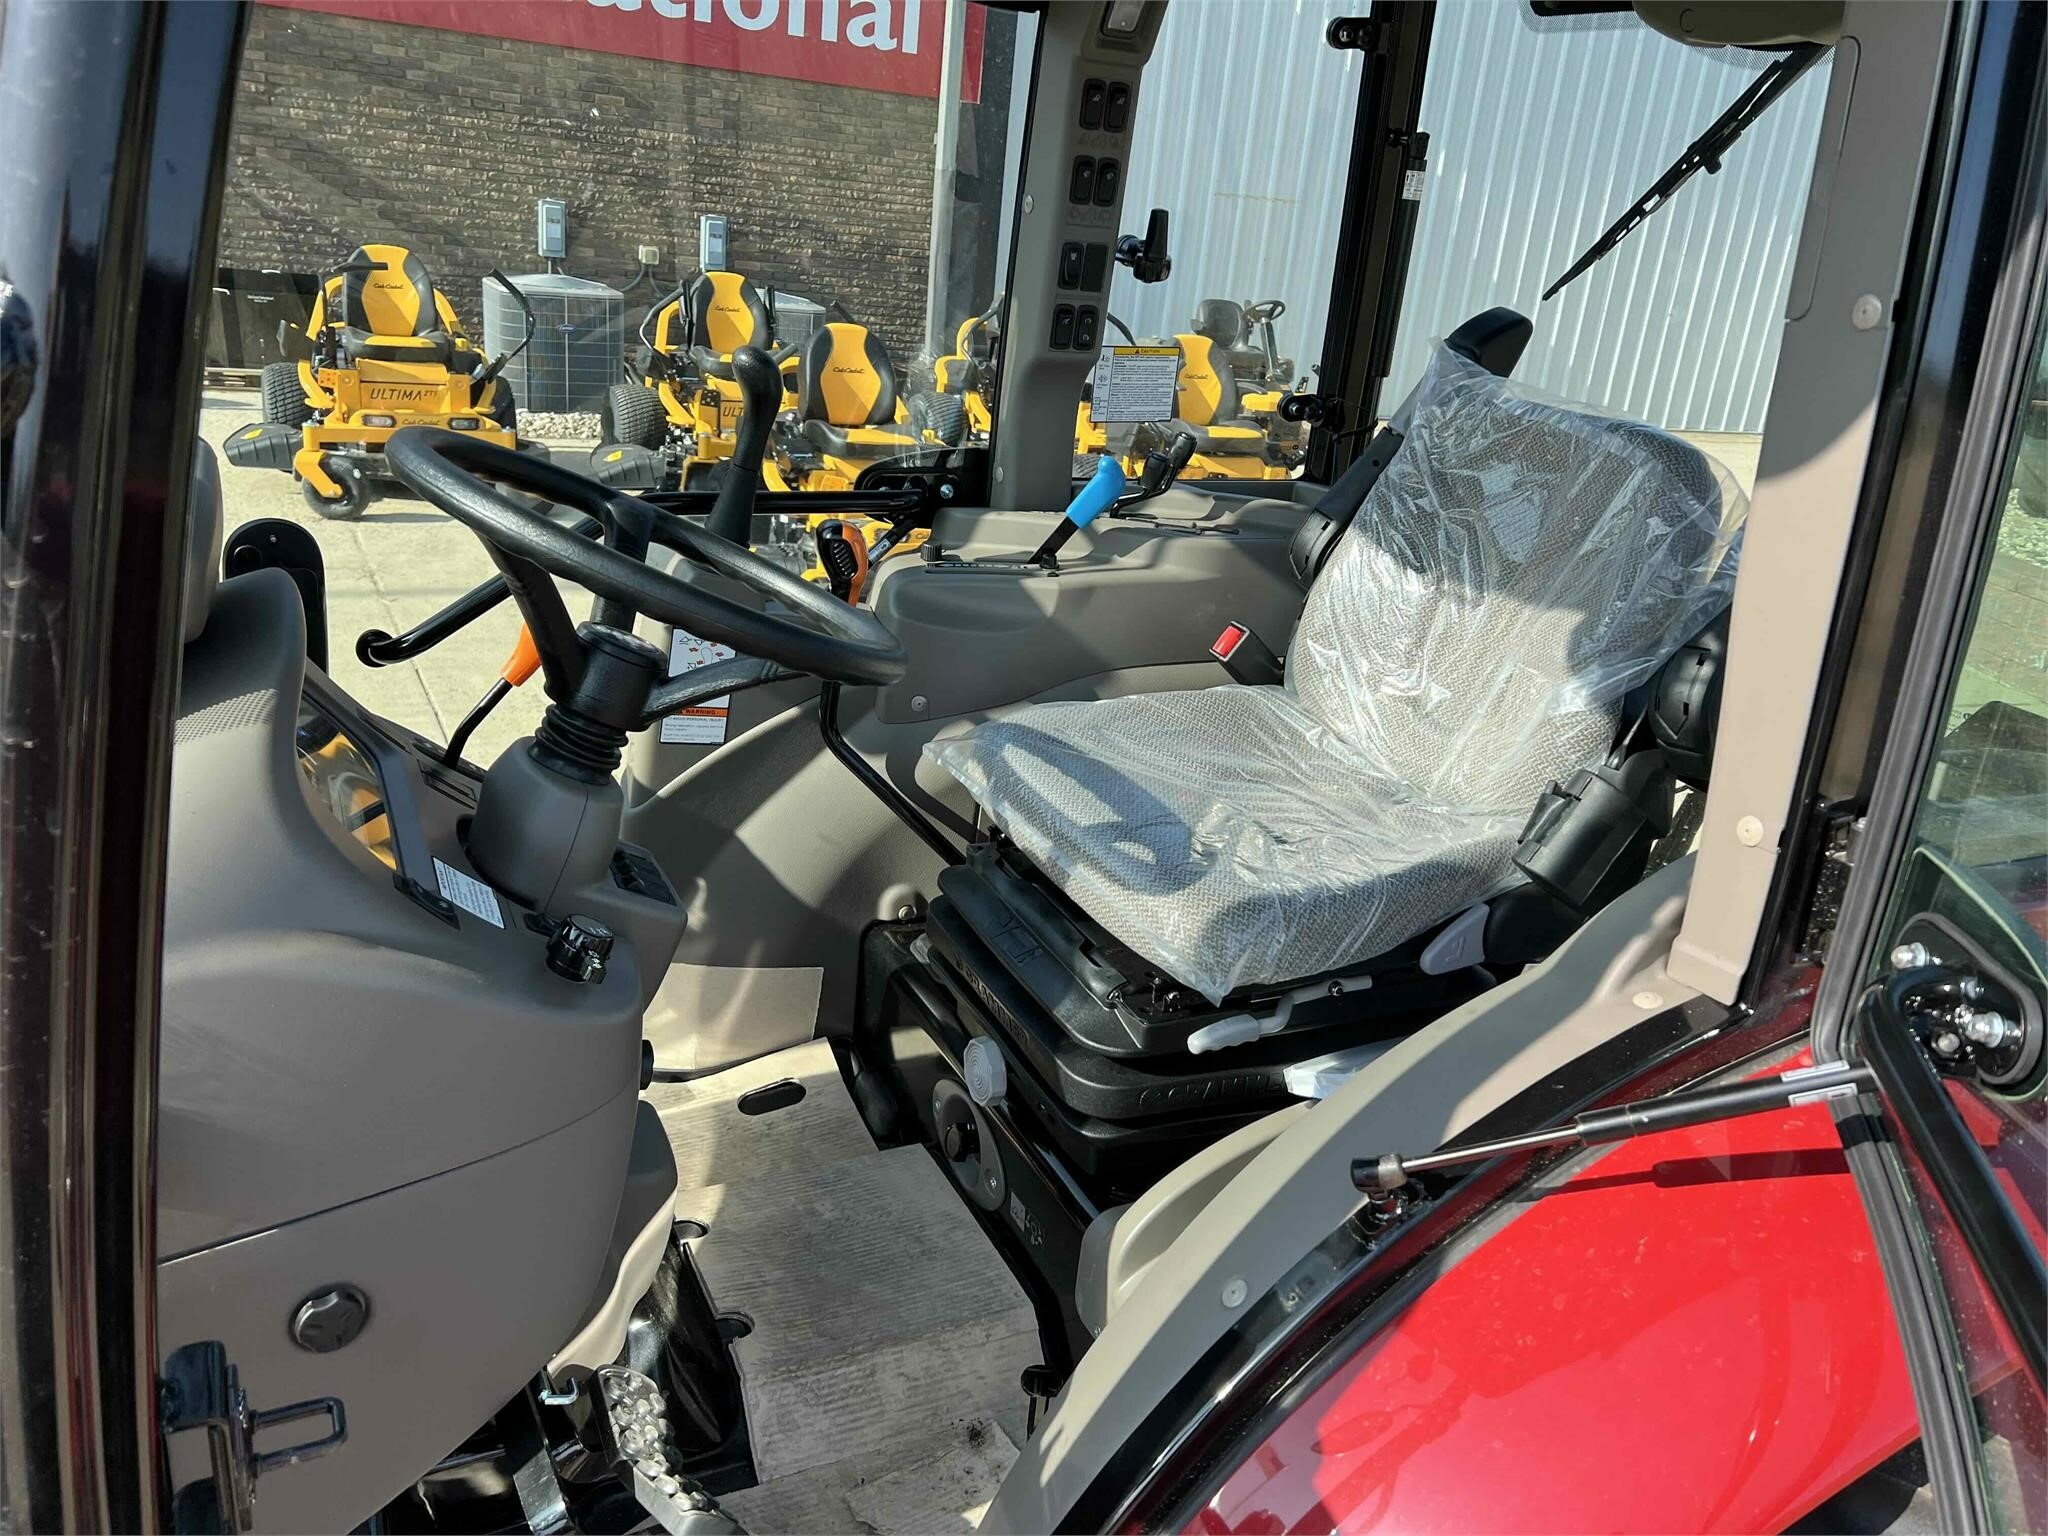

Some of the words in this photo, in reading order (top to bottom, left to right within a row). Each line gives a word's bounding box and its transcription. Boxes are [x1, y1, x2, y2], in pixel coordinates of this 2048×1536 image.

[584, 0, 919, 55] onal
[370, 388, 423, 401] ULTIMA
[722, 405, 744, 417] ULT
